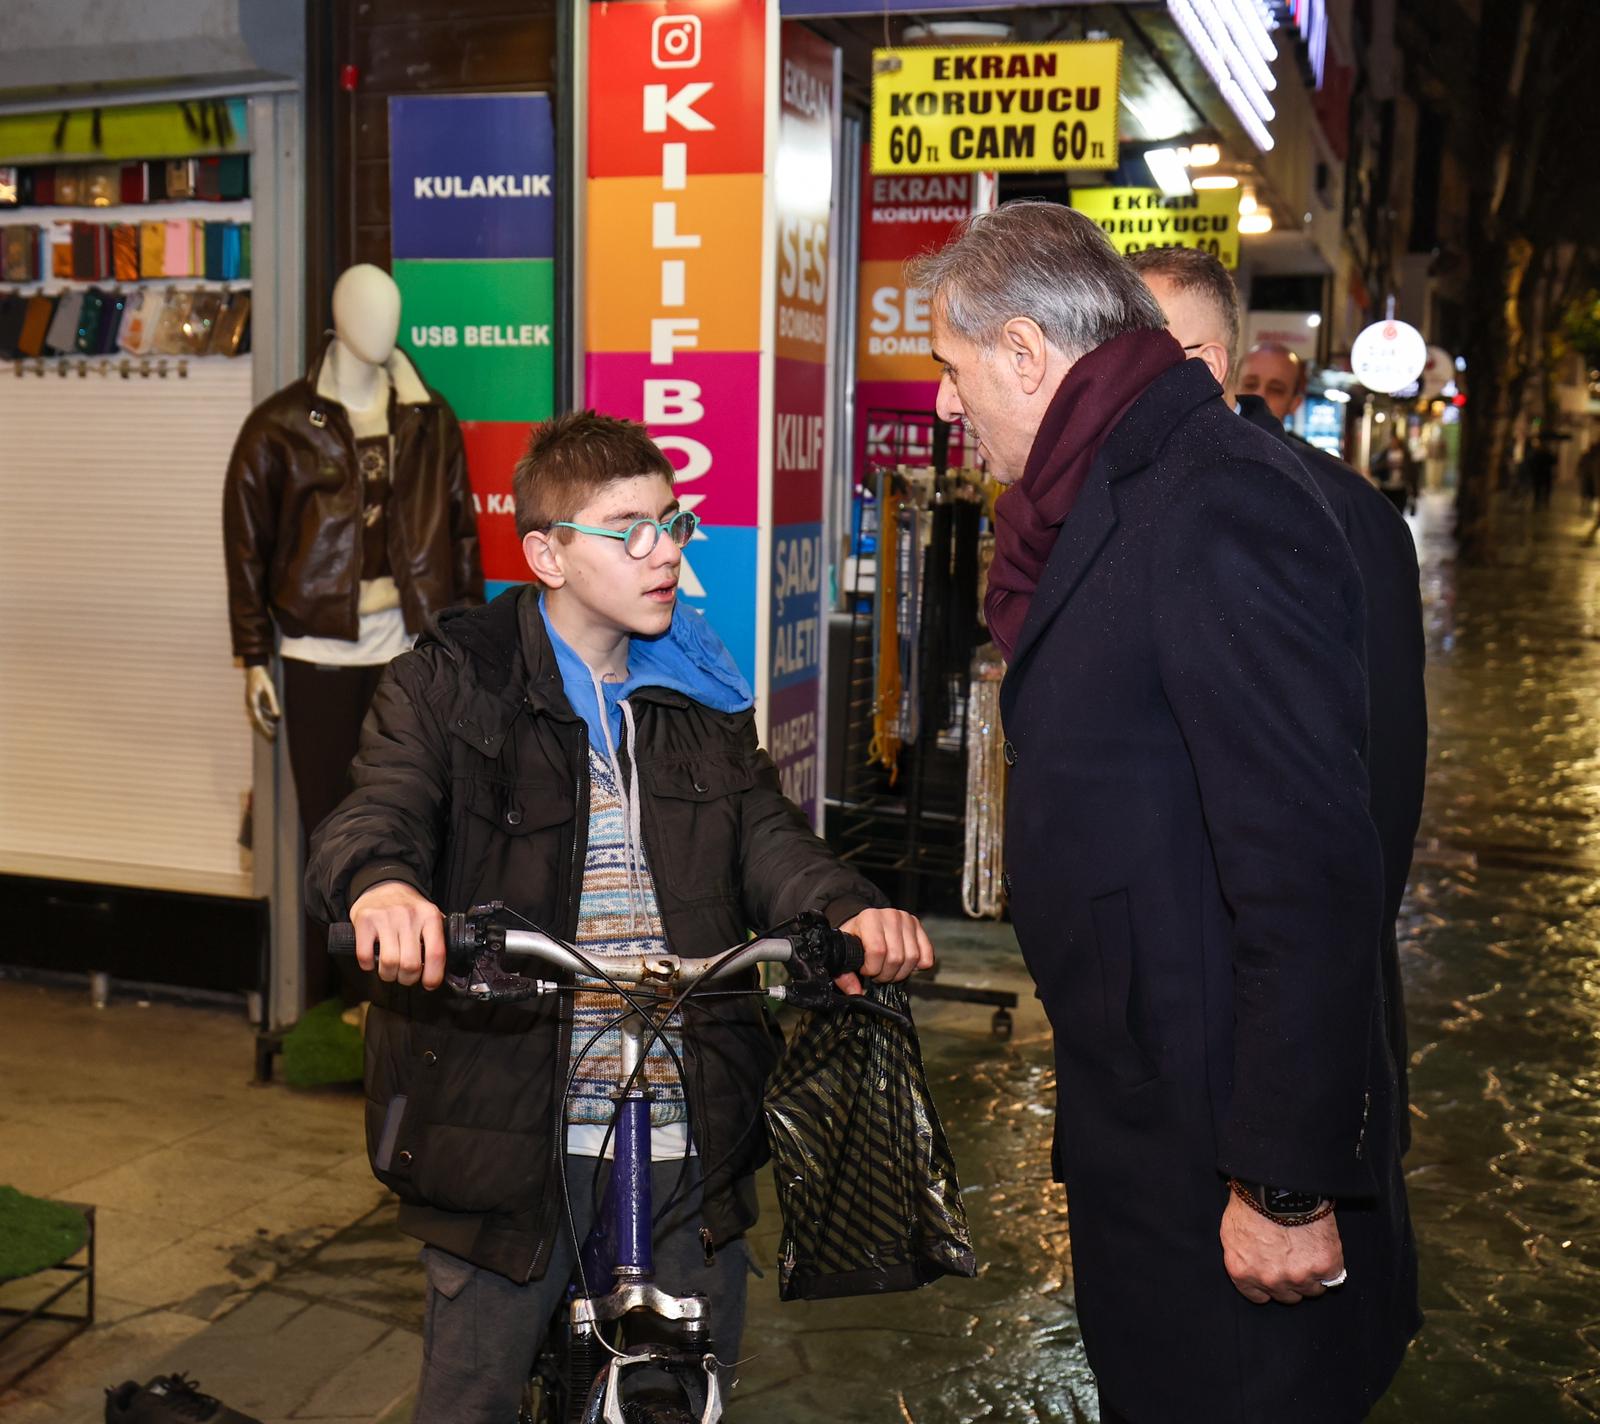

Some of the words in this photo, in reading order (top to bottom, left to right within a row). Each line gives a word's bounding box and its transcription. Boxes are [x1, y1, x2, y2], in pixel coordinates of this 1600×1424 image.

[933, 53, 1057, 81] EKRAN
[890, 86, 1101, 117] KORUYUCU
[889, 125, 922, 165] 60
[950, 124, 1036, 160] CAM
[1053, 120, 1088, 161] 60
[413, 174, 552, 199] KULAKLIK
[873, 176, 968, 202] EKRAN
[871, 206, 969, 225] KORUYUCU
[1113, 194, 1200, 211] EKRAN
[1095, 214, 1230, 235] ORUYUCU
[781, 218, 826, 306] SES
[870, 286, 932, 334] SE
[411, 325, 458, 348] USB
[464, 324, 550, 347] BELLEK
[868, 336, 933, 357] BOMB
[776, 412, 823, 472] KILIF
[774, 535, 820, 617] ŞARJ
[779, 752, 816, 807] ARTI
